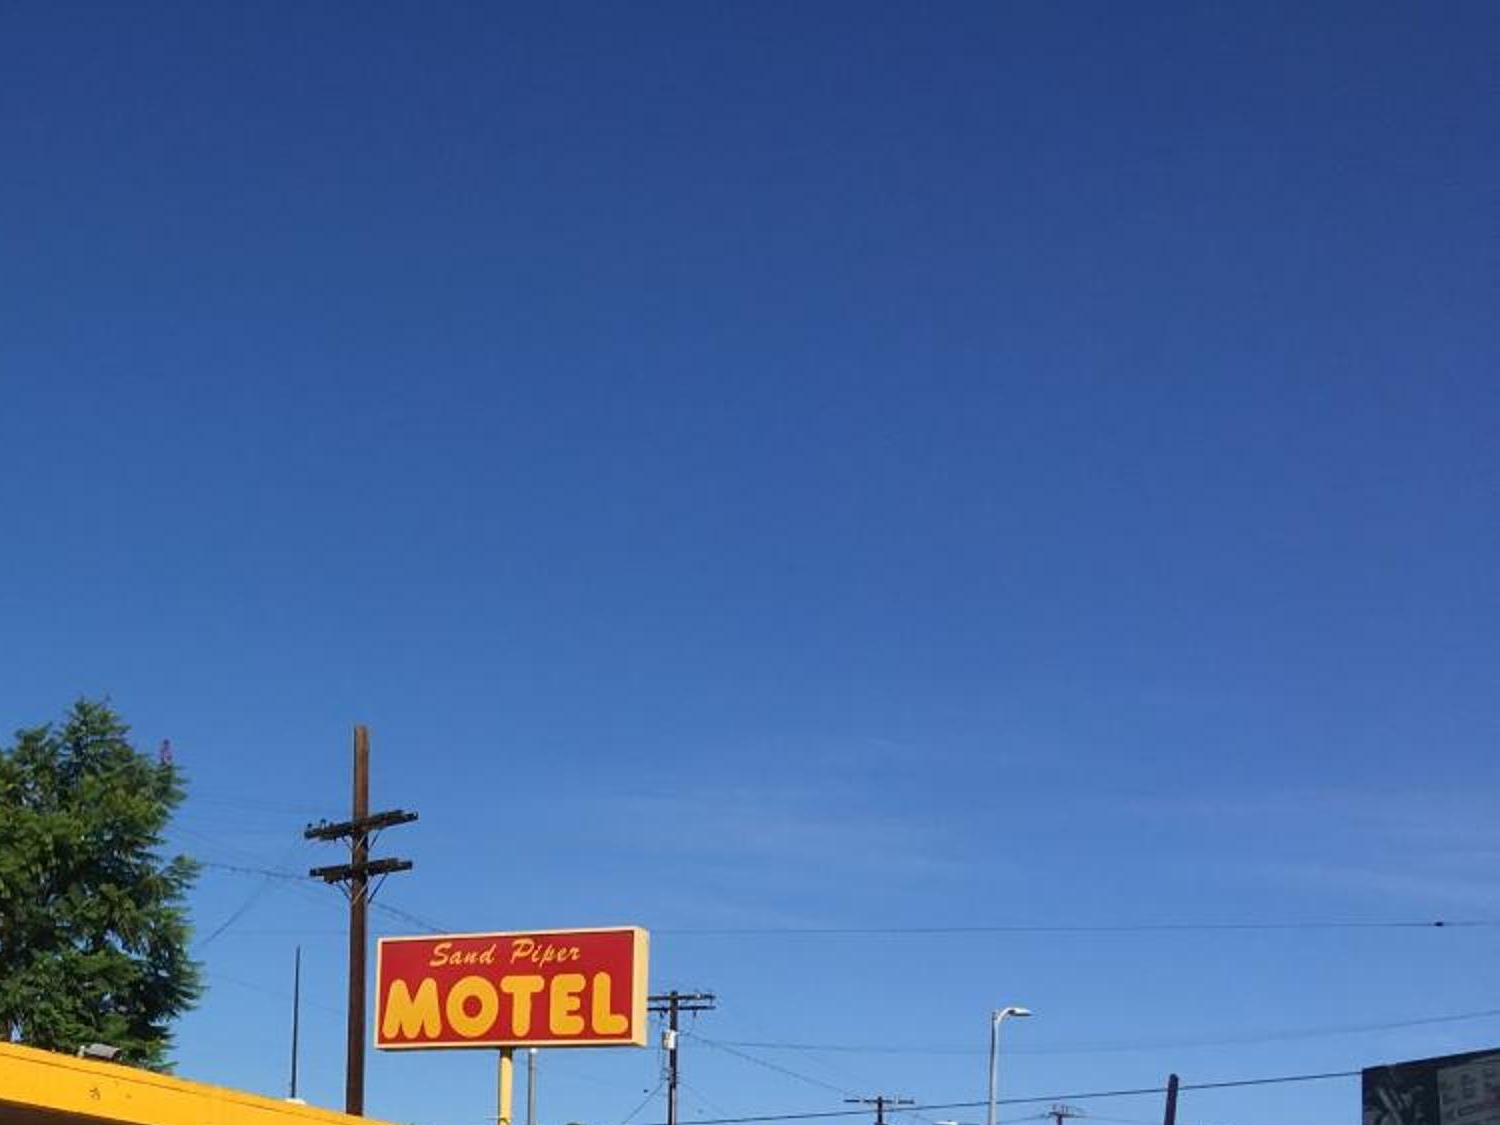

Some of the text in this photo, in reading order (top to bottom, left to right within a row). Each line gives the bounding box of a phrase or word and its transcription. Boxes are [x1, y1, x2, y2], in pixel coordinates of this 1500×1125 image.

[429, 938, 581, 969] Sand Piper
[382, 971, 629, 1039] MOTEL
